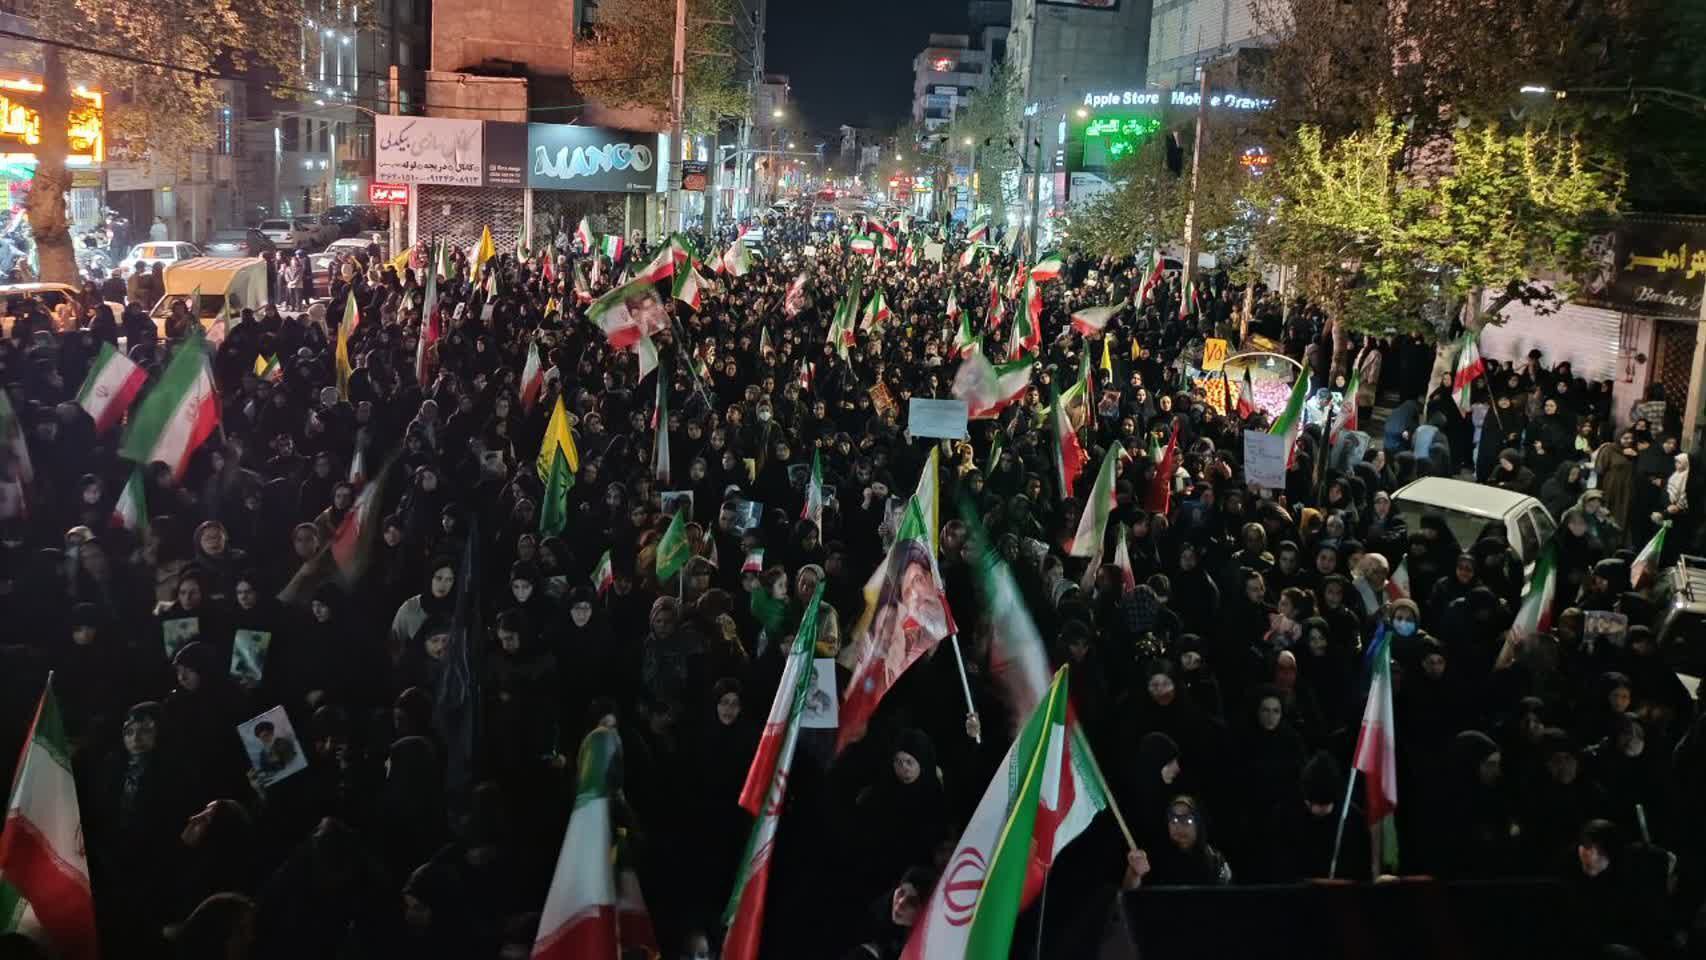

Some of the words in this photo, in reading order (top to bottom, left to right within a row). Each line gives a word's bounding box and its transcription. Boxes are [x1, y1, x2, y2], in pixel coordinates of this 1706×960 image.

[1083, 92, 1120, 108] Apple
[1122, 91, 1159, 105] Store
[1170, 91, 1221, 107] Mobe
